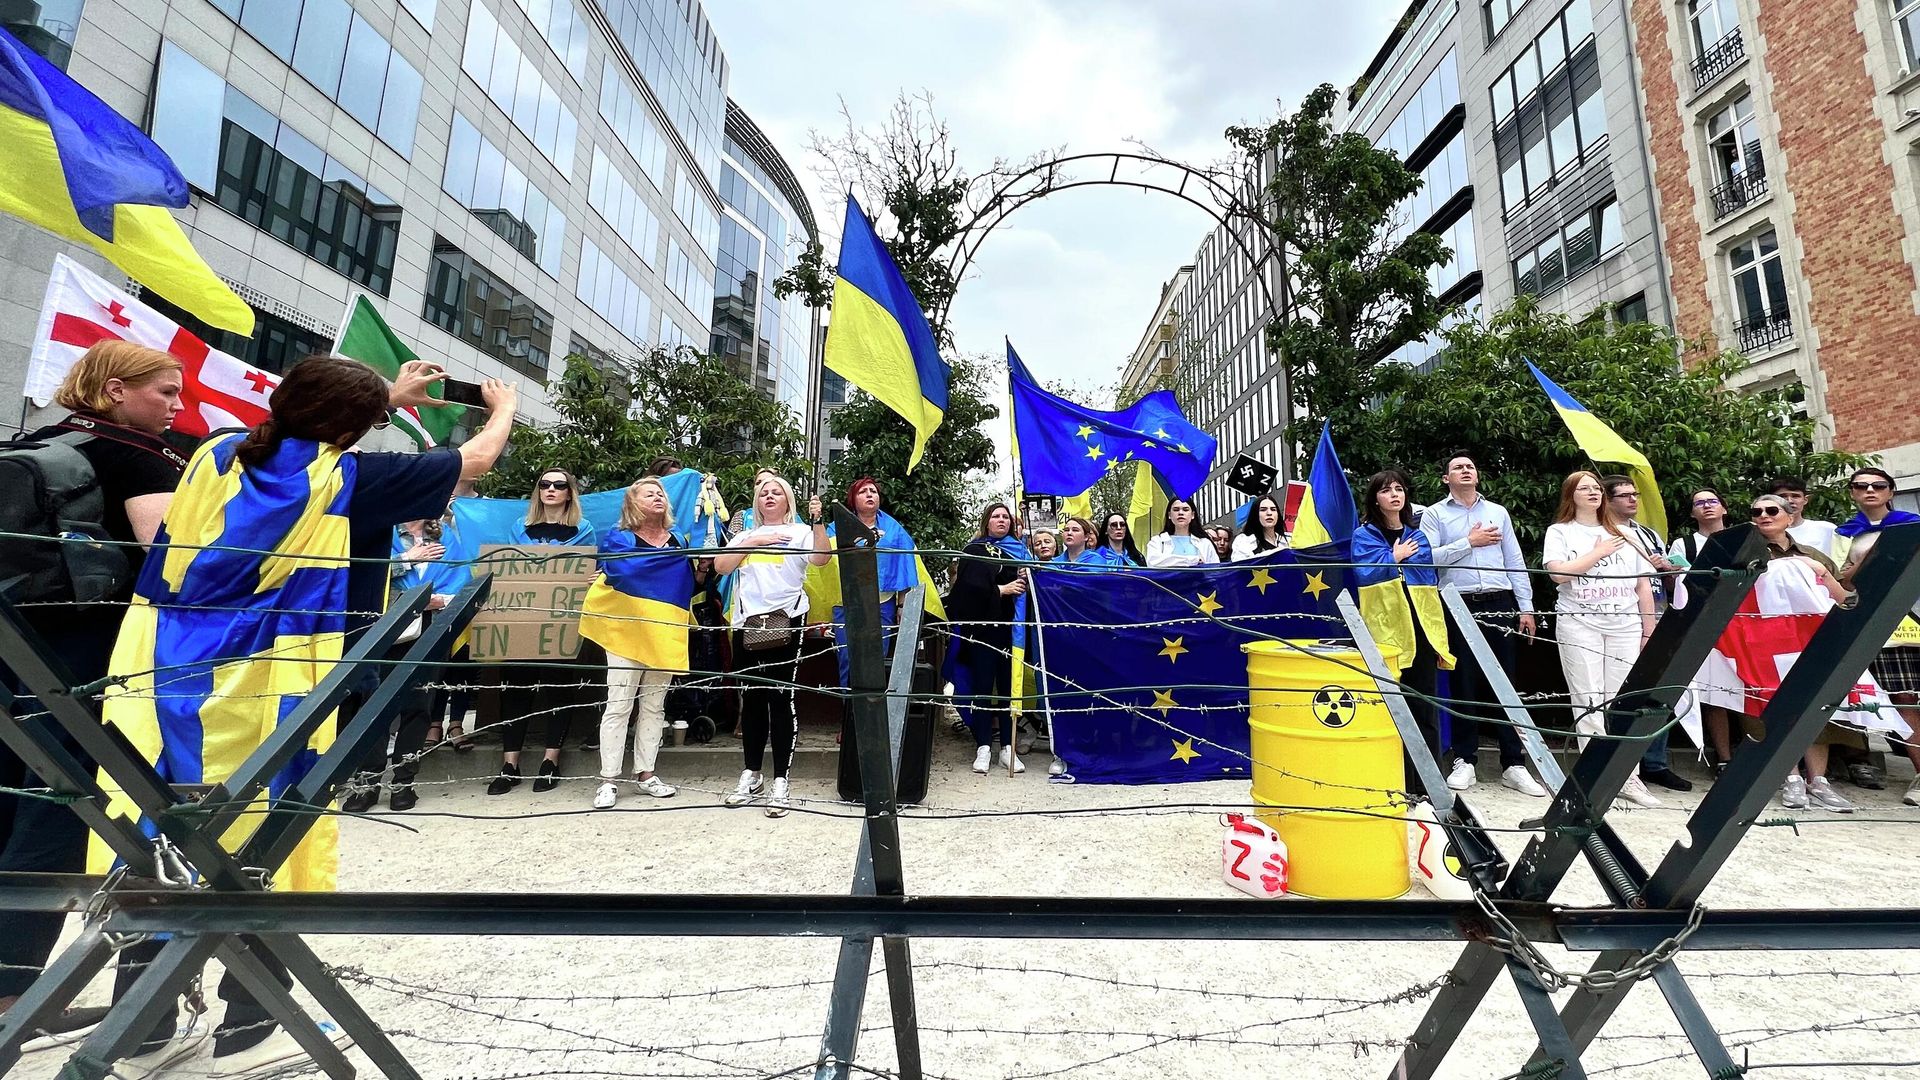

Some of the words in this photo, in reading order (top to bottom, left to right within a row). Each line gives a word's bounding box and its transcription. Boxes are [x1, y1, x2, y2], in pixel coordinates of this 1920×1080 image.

[550, 586, 586, 618] BE
[472, 624, 510, 657] IN
[538, 623, 582, 657] EU
[1230, 838, 1252, 882] Z
